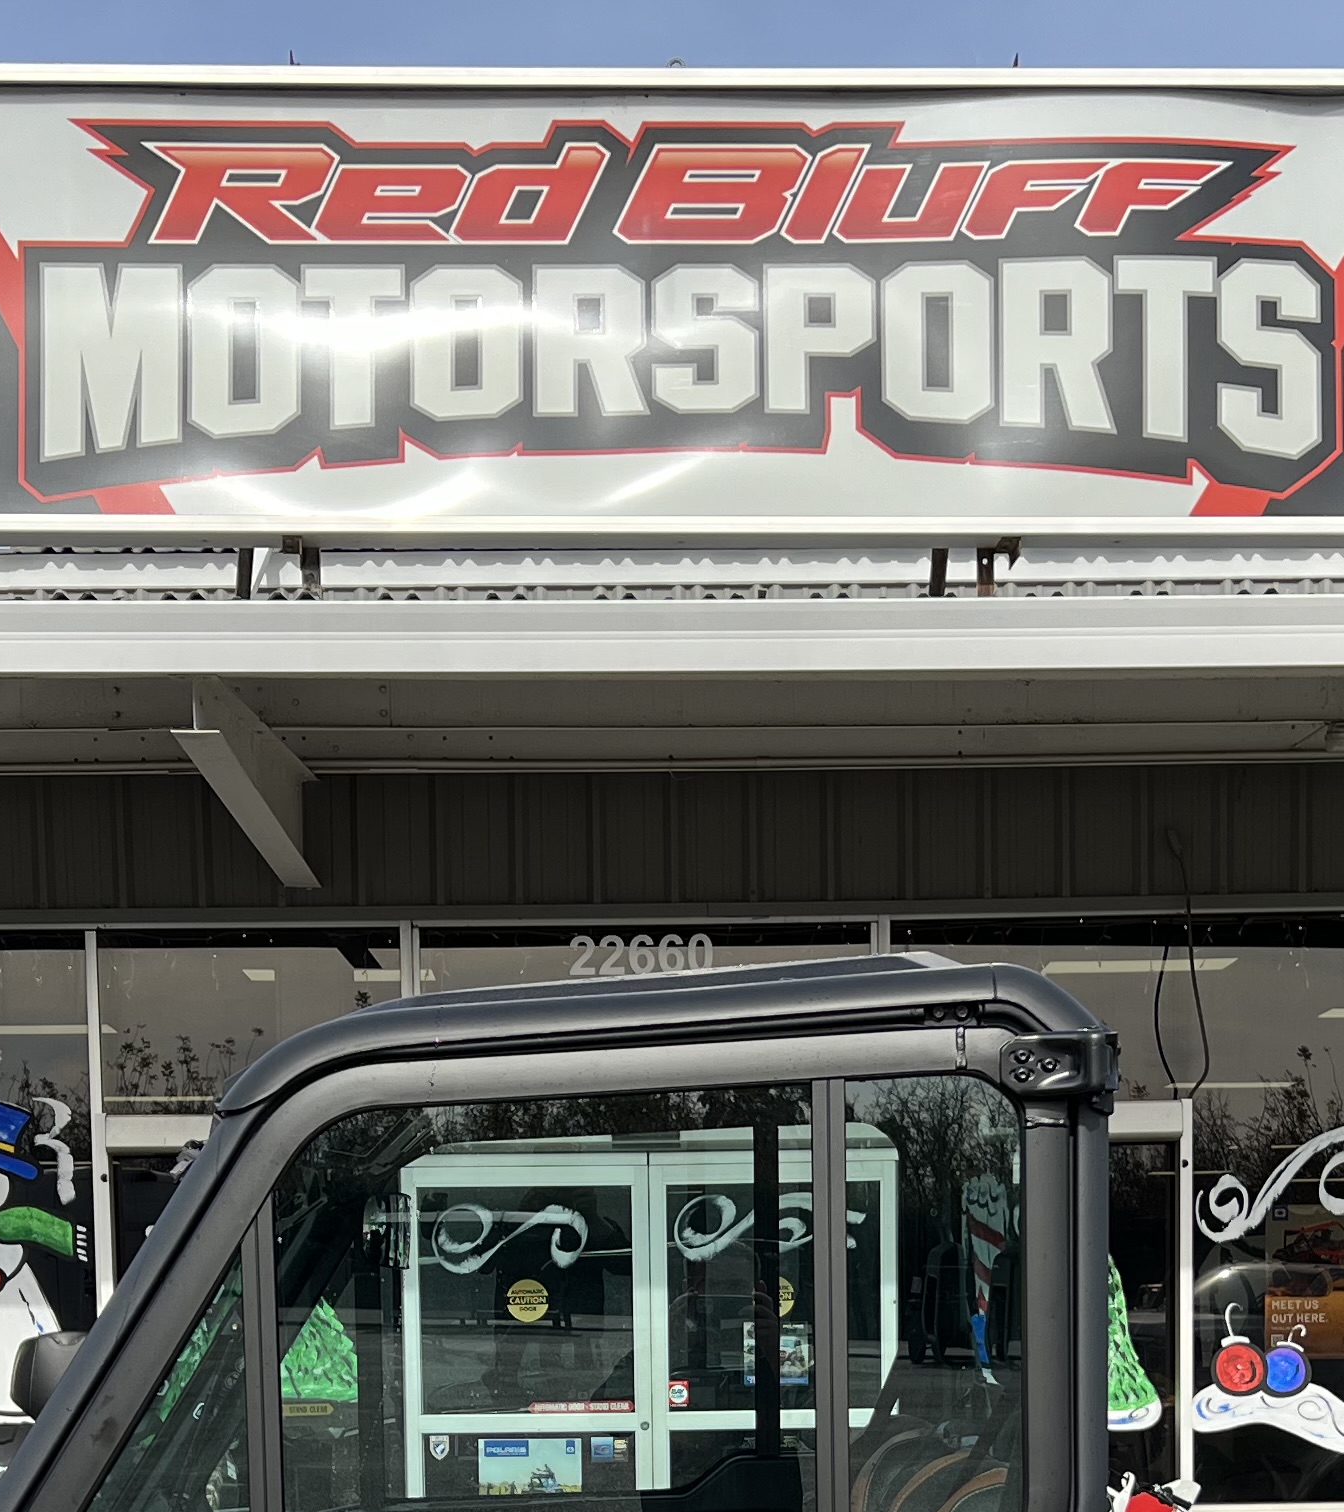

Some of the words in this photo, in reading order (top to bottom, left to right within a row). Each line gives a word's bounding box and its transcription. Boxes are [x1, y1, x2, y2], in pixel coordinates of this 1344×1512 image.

[143, 143, 606, 244] Red
[39, 253, 1332, 462] MOTORSPORTS
[569, 933, 714, 976] 22660
[509, 1296, 547, 1305] CAUTION
[1271, 1299, 1303, 1310] MEET
[1304, 1299, 1319, 1310] US
[1271, 1313, 1294, 1324] OUT
[1296, 1312, 1329, 1323] HERE.
[485, 1446, 527, 1454] POLARIS
